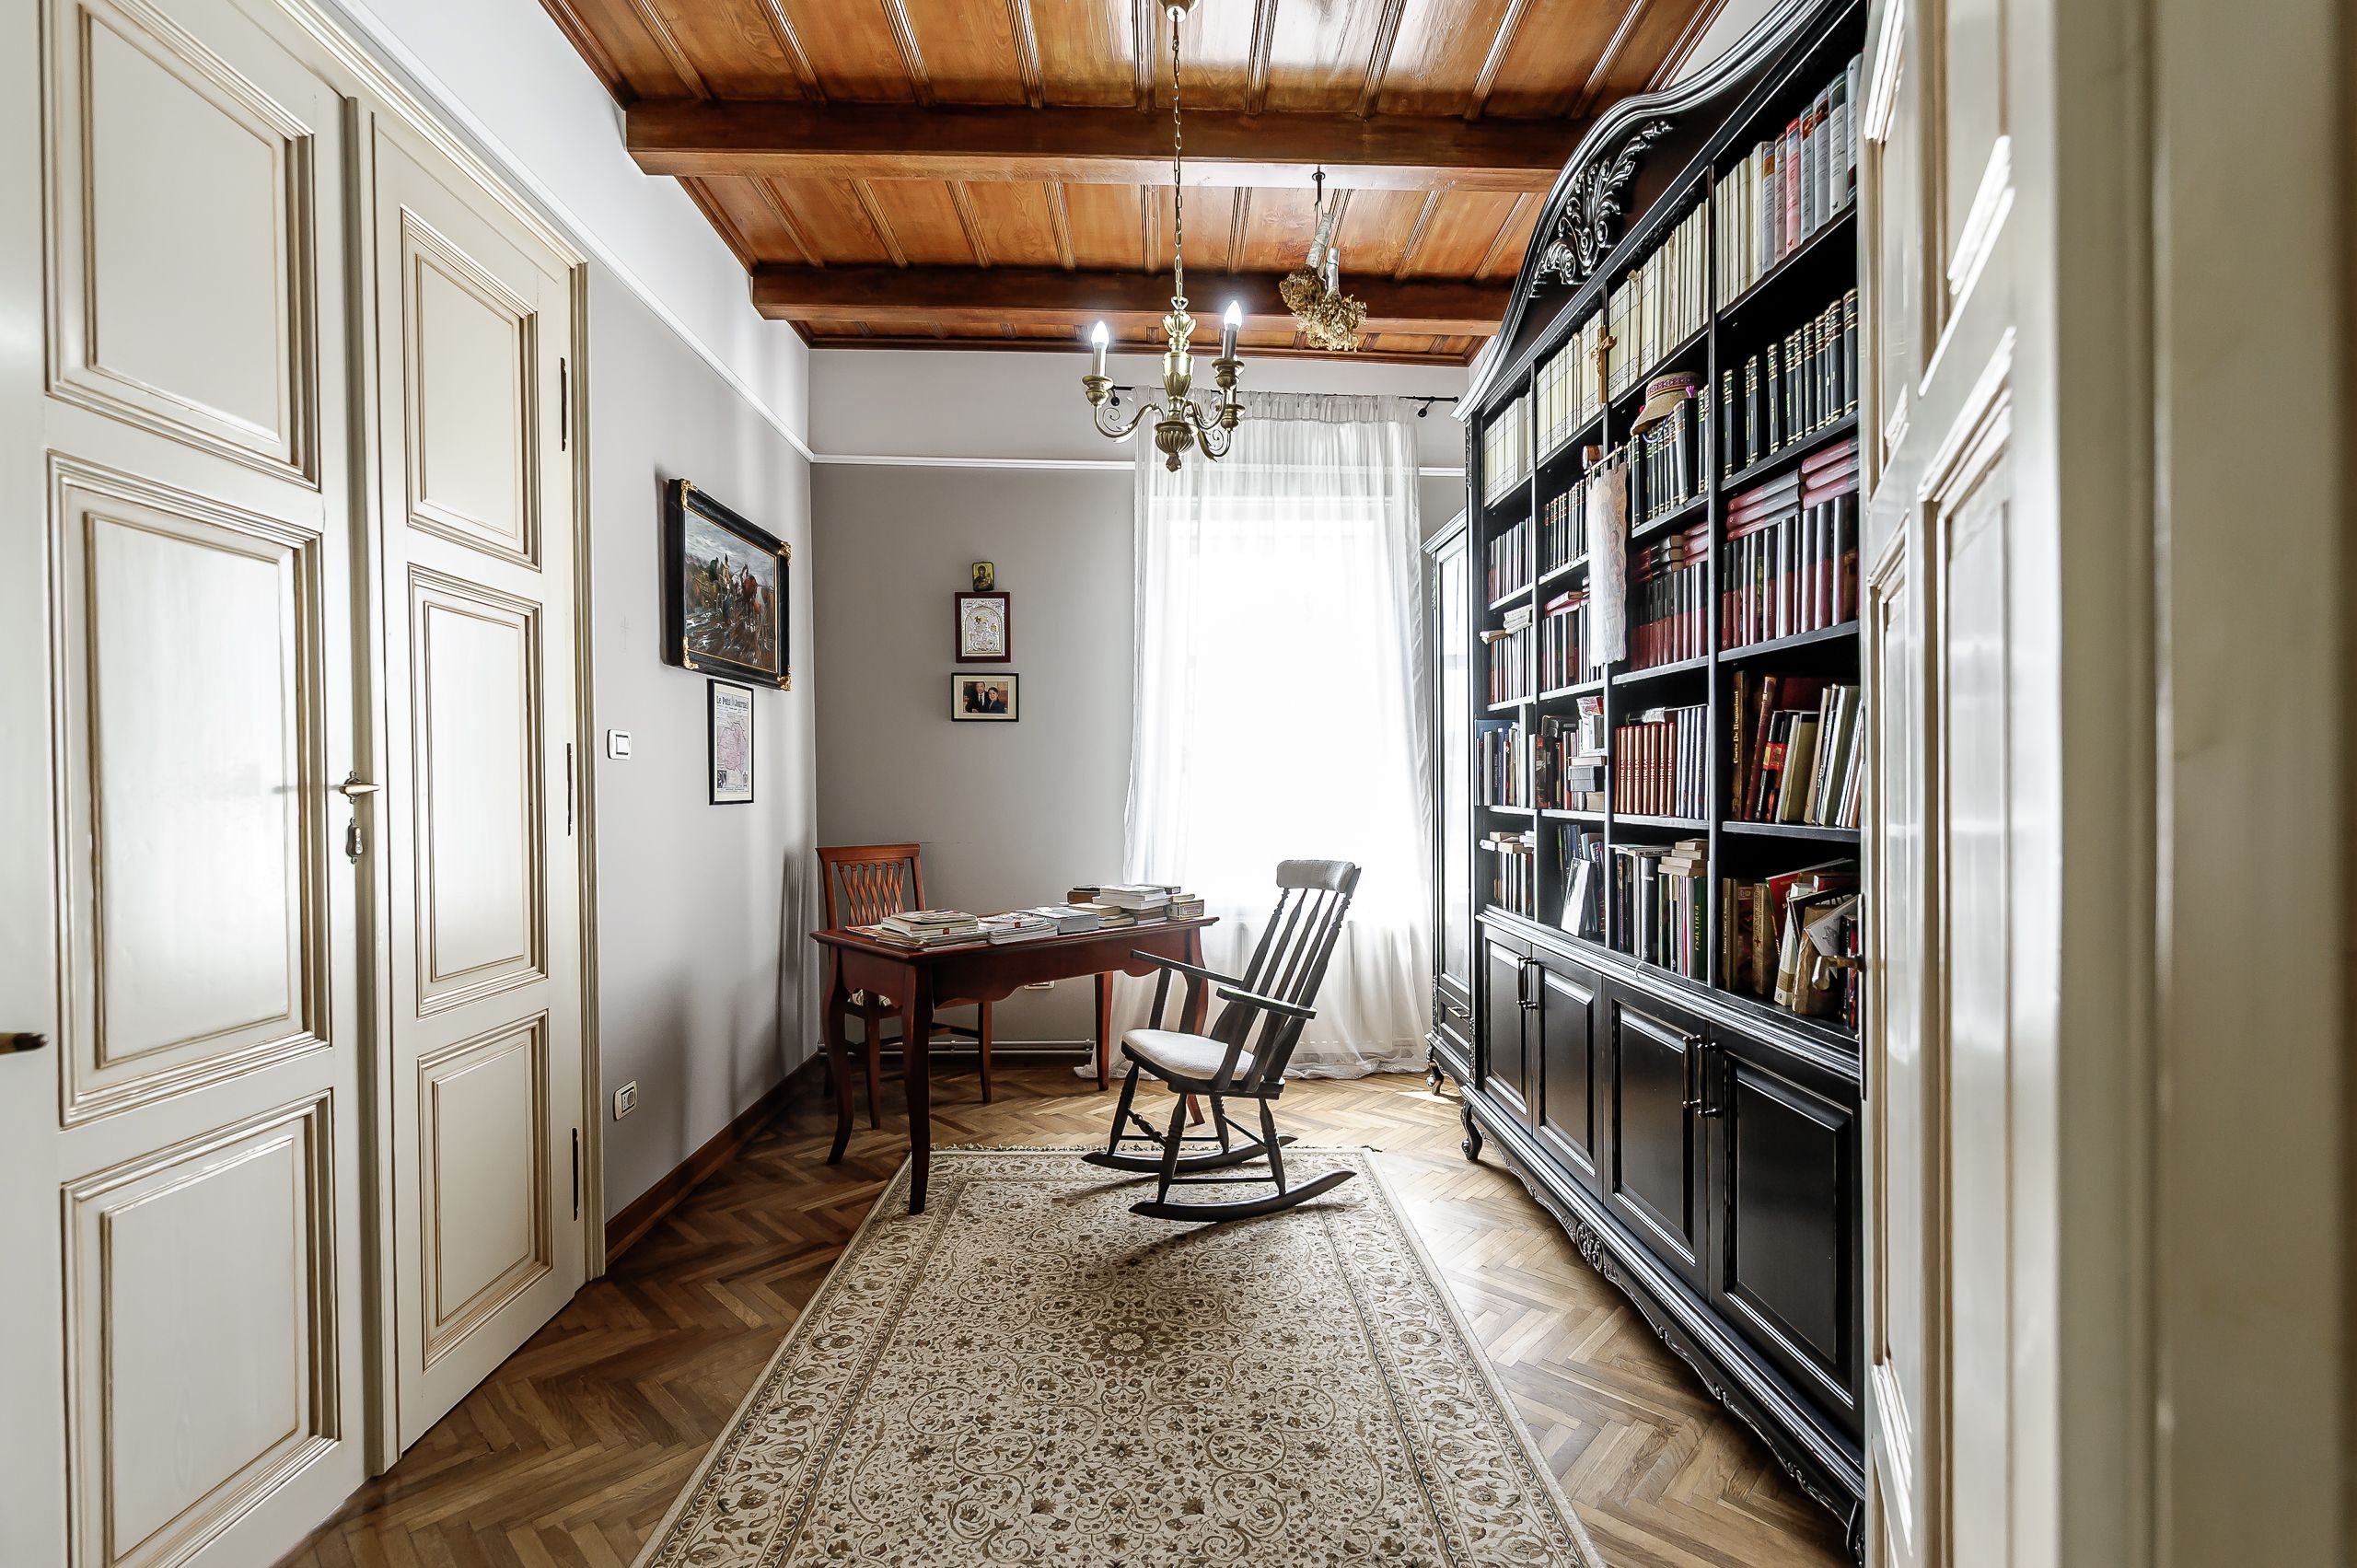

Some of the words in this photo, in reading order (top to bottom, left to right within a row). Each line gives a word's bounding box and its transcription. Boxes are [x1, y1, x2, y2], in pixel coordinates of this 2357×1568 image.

[716, 695, 722, 704] Le
[722, 697, 731, 706] Petit
[734, 699, 749, 709] Journal
